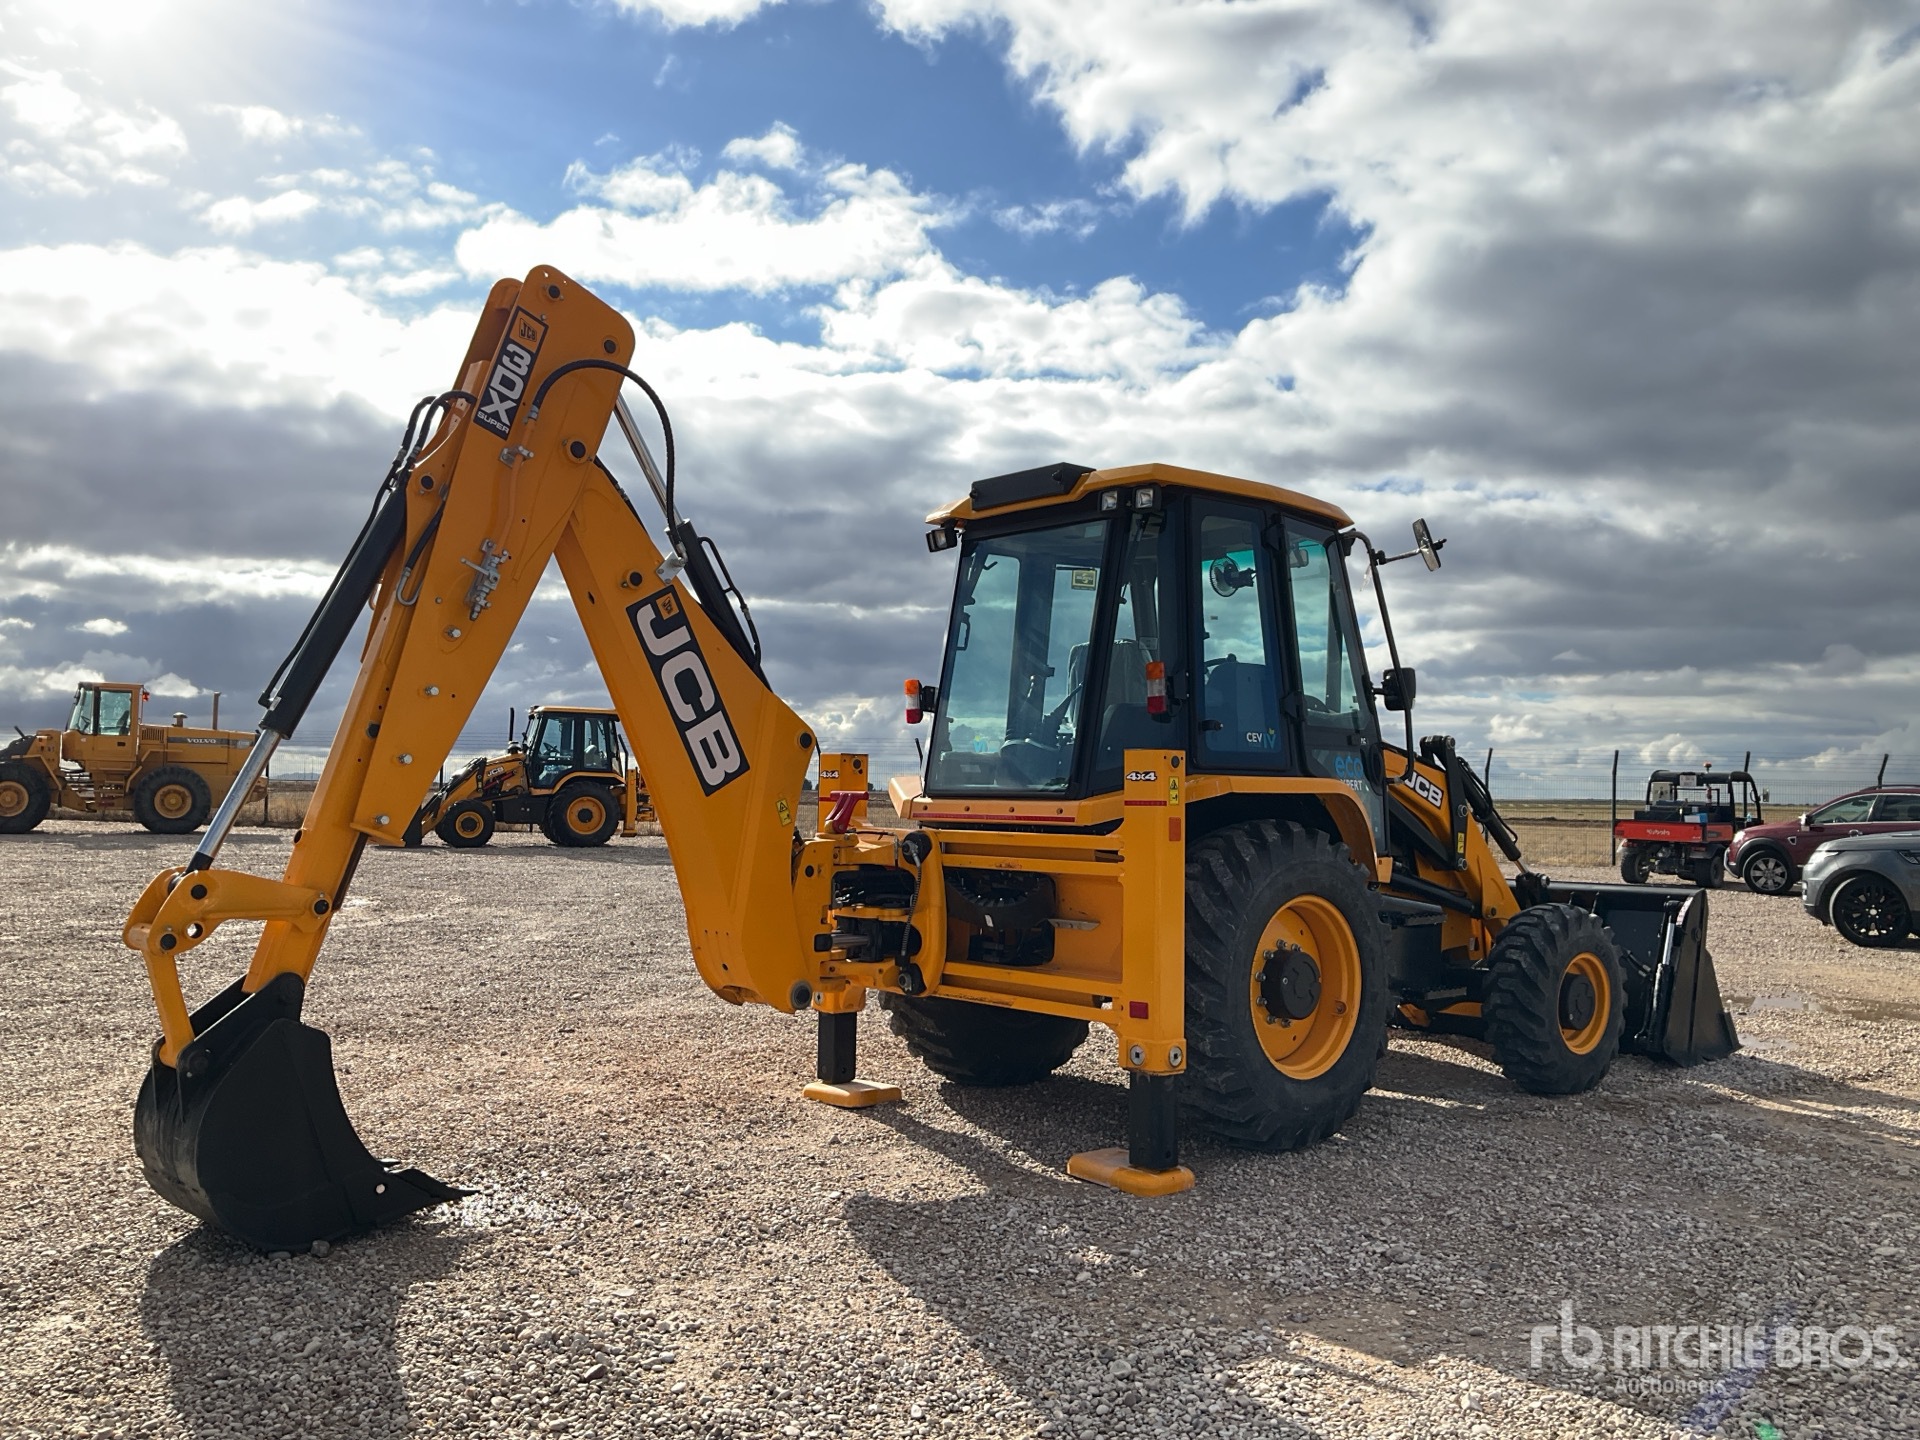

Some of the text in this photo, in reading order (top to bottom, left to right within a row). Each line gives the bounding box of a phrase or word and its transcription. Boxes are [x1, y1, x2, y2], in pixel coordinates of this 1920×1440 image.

[520, 321, 536, 341] JCB
[480, 343, 532, 427] 3DX
[477, 410, 510, 434] SUPER
[636, 603, 741, 786] JCB
[1246, 732, 1263, 743] CEV
[488, 766, 504, 777] JCB
[820, 770, 840, 779] 4x4
[1126, 771, 1157, 781] 4x4
[1334, 755, 1363, 779] eco
[1404, 771, 1443, 808] JCB
